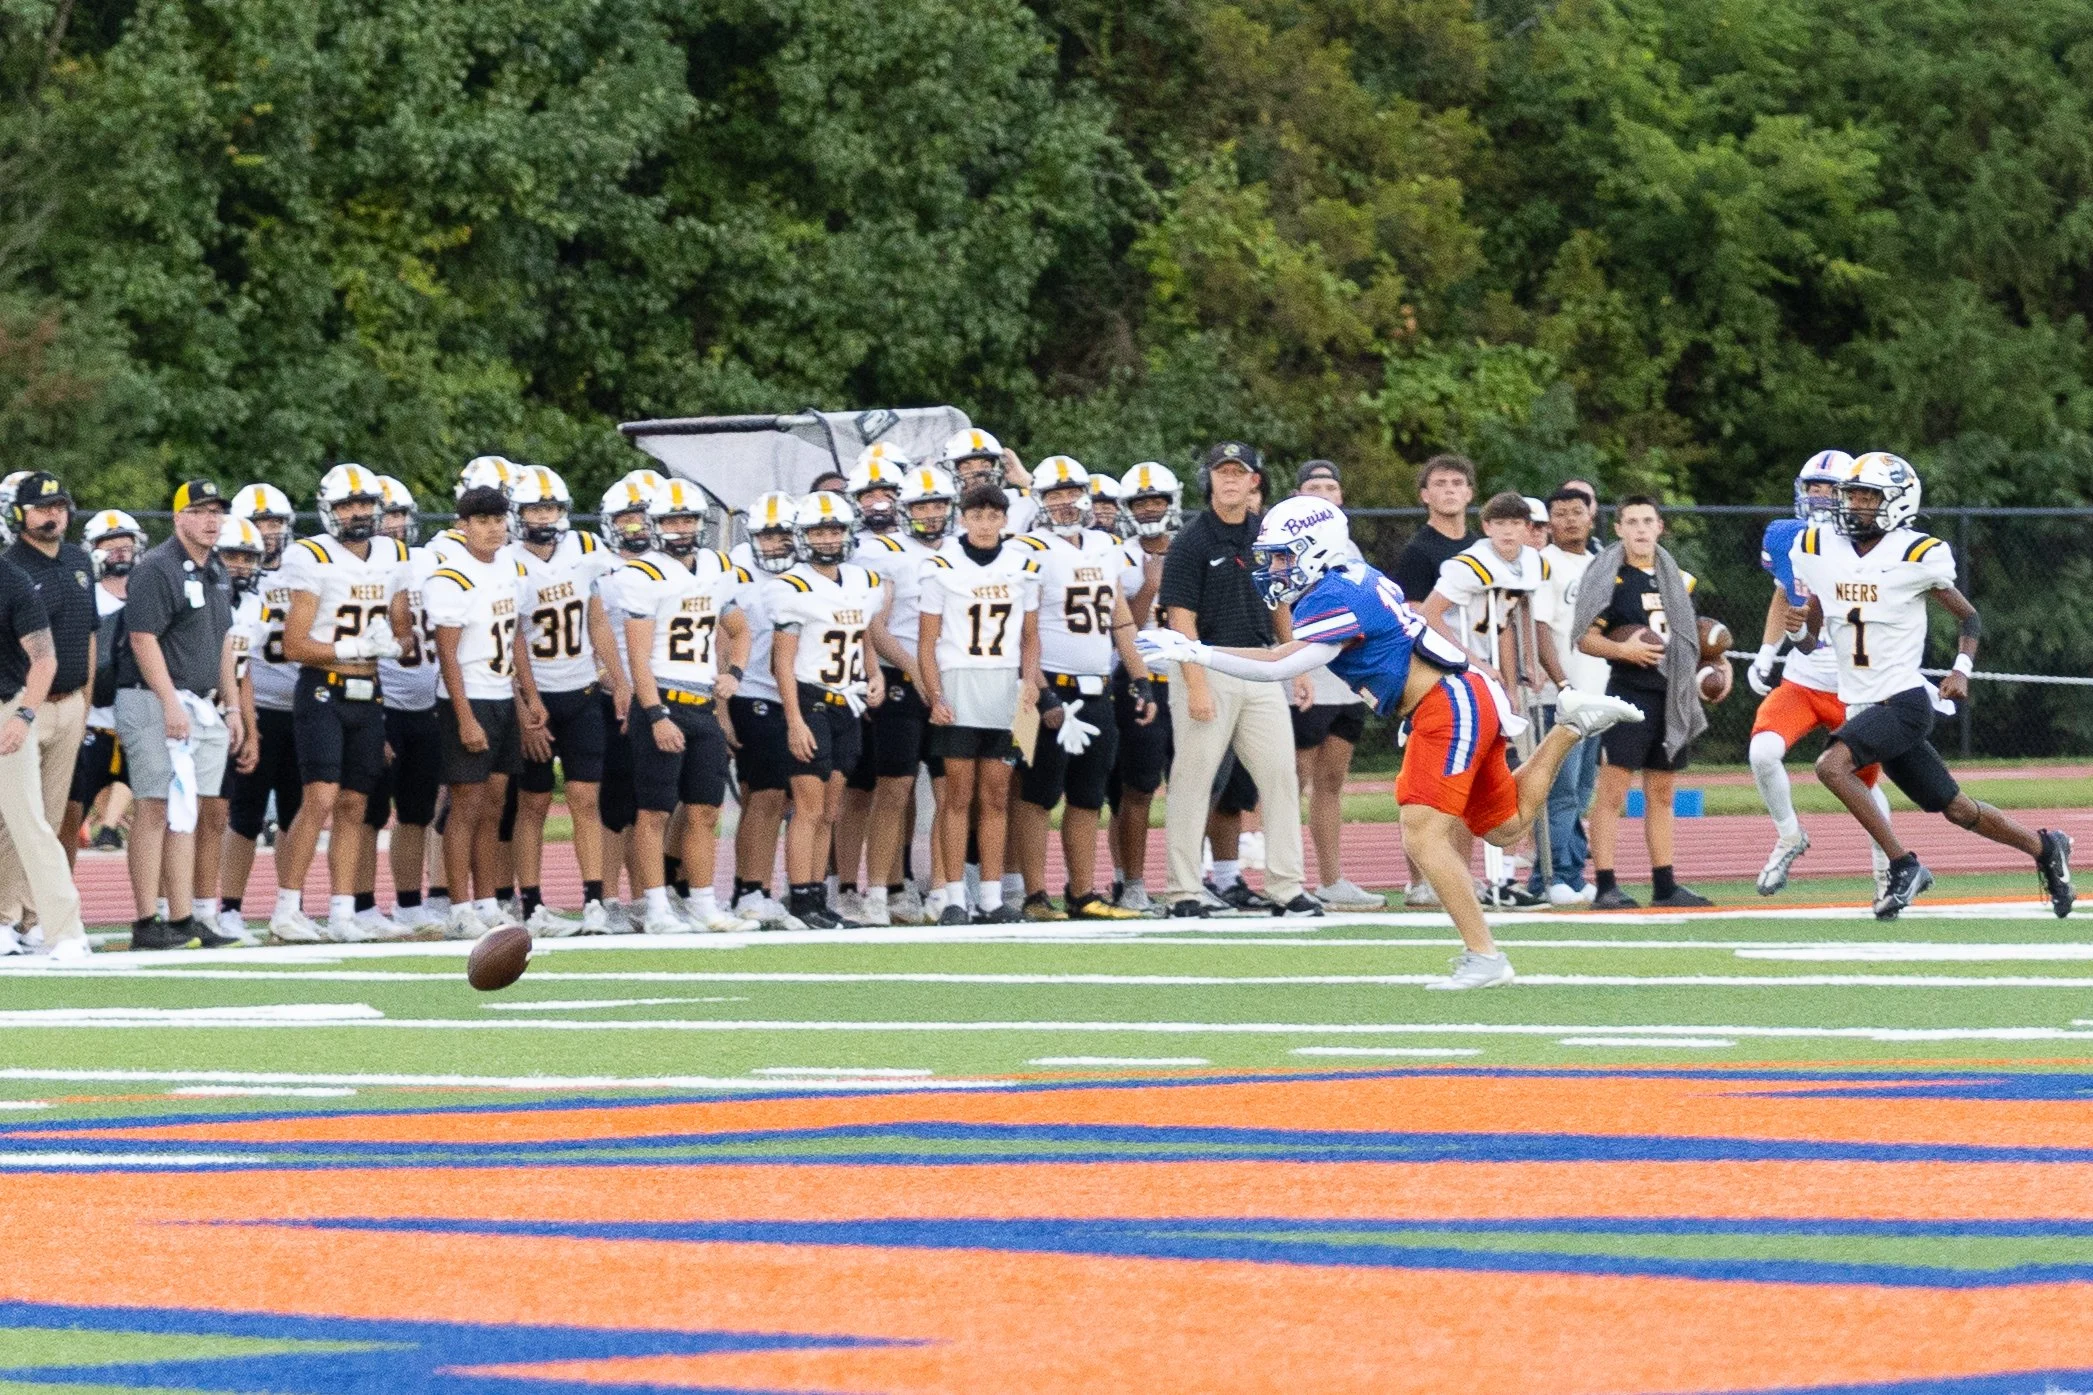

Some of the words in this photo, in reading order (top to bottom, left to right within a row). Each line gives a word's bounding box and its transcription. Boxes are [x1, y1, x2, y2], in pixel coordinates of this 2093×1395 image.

[1284, 508, 1335, 537] Bruins
[971, 584, 1010, 600] NEERS
[1835, 583, 1878, 602] NEERS
[531, 600, 584, 658] 30
[669, 615, 716, 664] 27
[967, 603, 1013, 657] 17
[1846, 607, 1870, 667] 1
